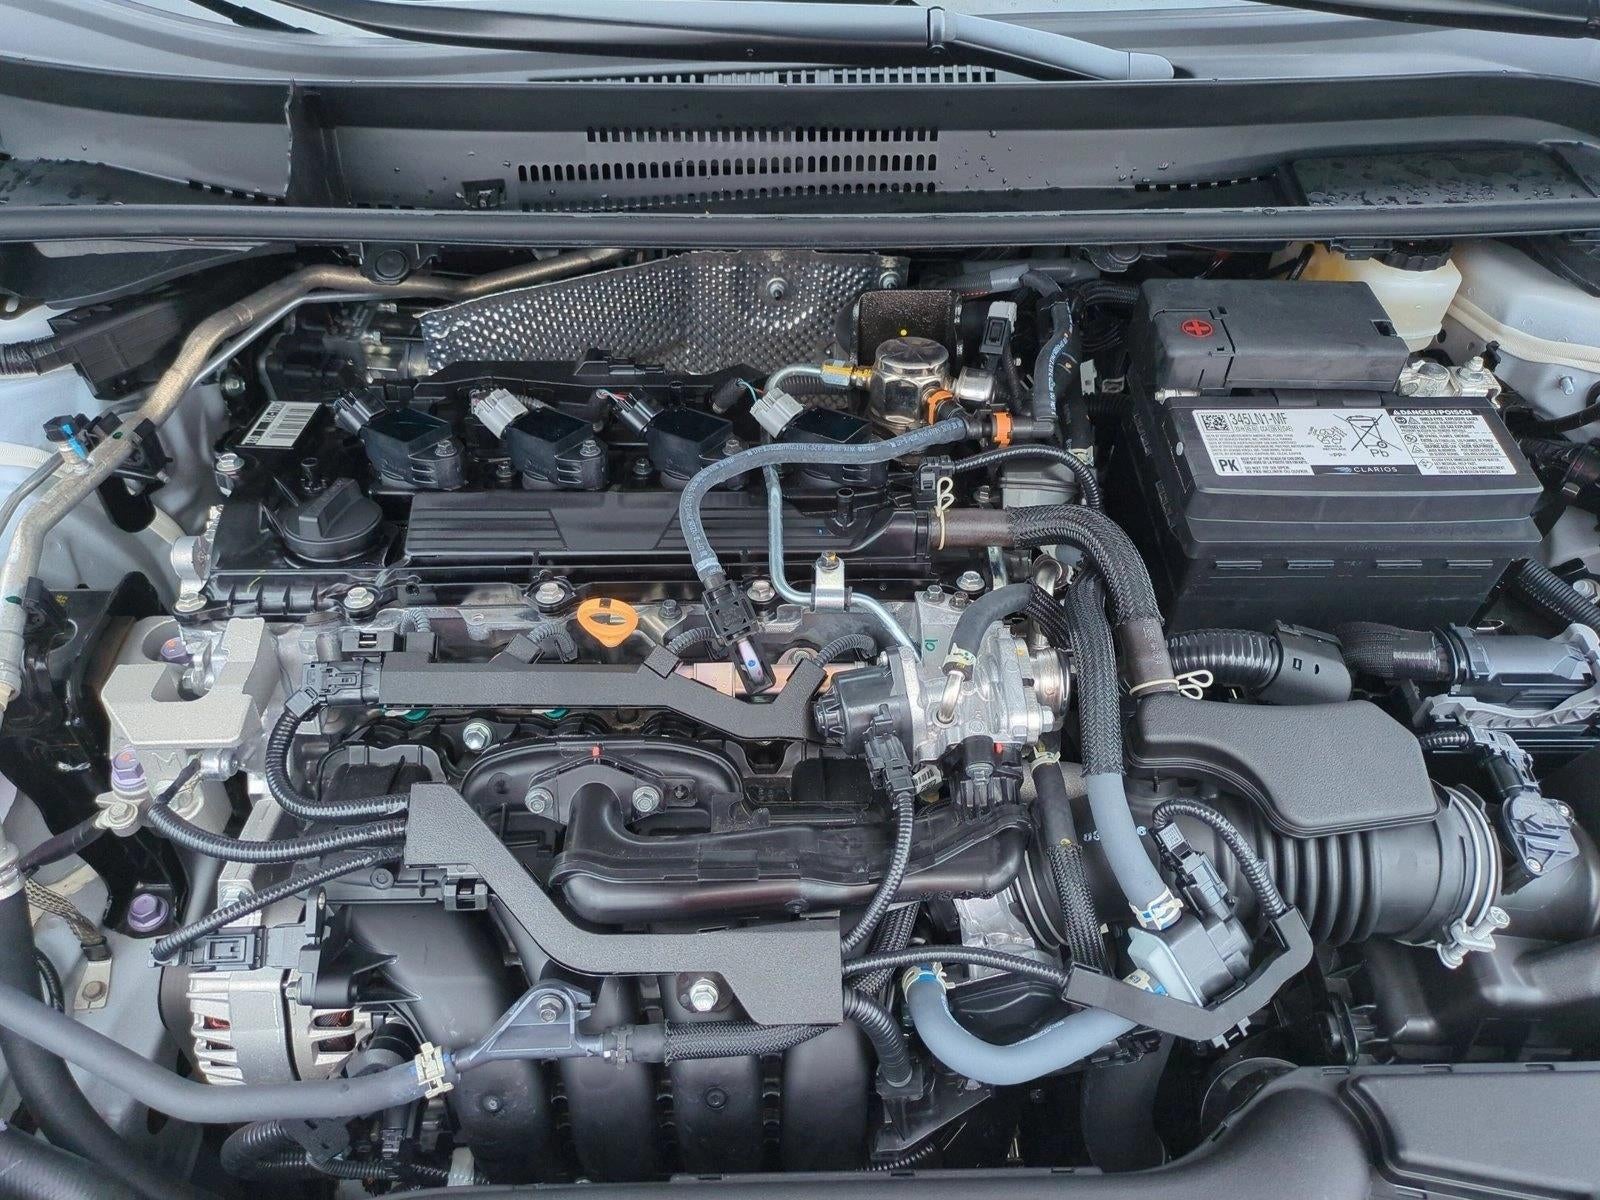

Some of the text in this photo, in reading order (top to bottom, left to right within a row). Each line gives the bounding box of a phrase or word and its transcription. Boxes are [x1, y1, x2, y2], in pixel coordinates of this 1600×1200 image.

[1229, 412, 1289, 425] 345LN1-MF
[1369, 449, 1390, 458] Pb
[1218, 459, 1240, 472] PK
